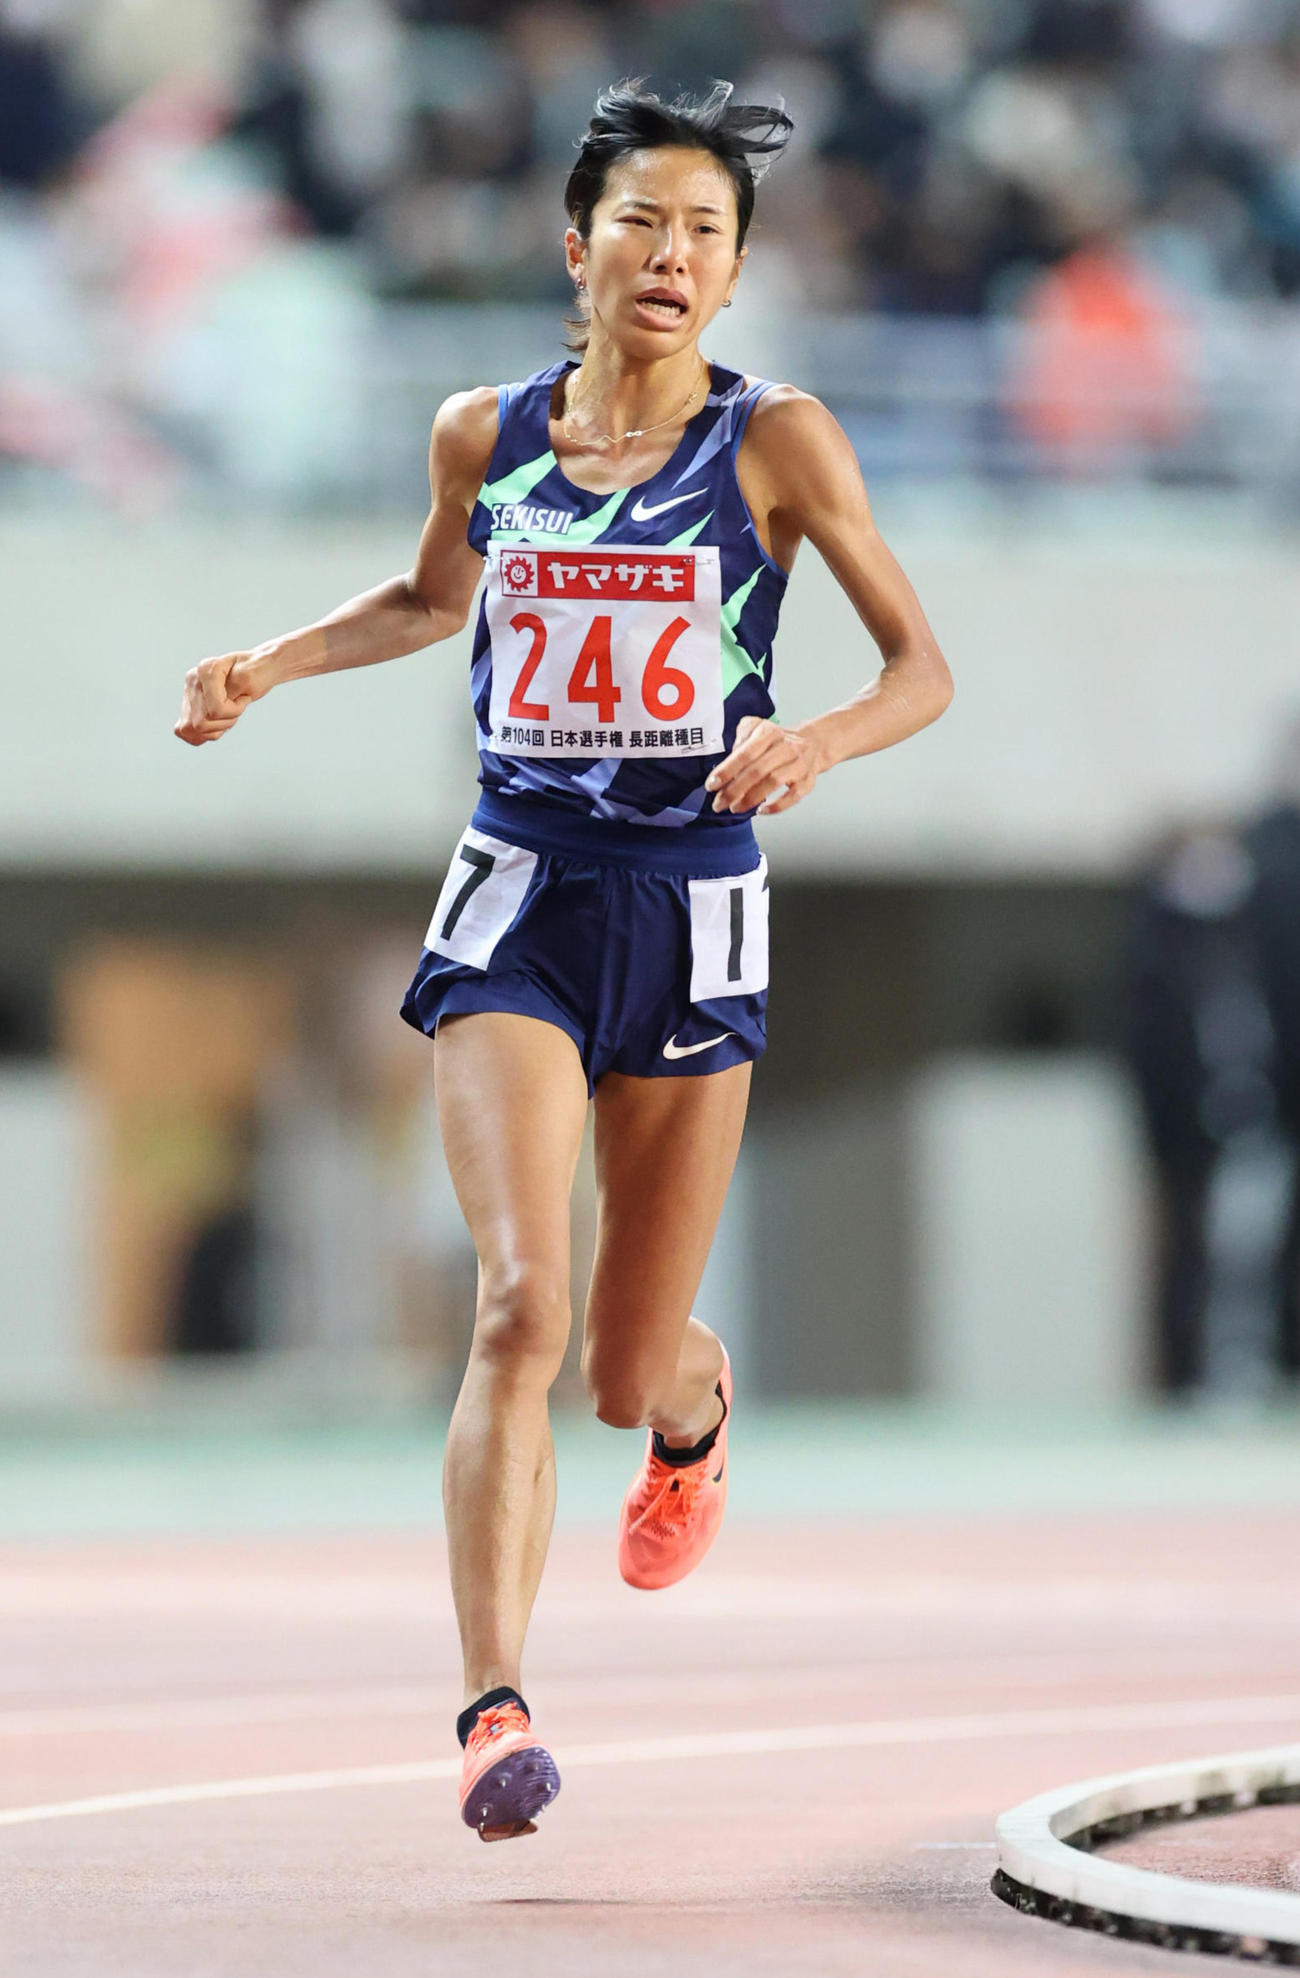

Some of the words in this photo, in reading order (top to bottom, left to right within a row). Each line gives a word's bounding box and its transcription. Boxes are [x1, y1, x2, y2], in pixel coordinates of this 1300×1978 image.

[490, 503, 573, 534] SEKISUI
[547, 562, 684, 592] ヤマザキ
[508, 612, 695, 723] 246
[501, 726, 544, 747] 第104回
[551, 729, 623, 747] 日本選手権
[629, 727, 704, 748] 長距離種目
[440, 844, 496, 941] 7
